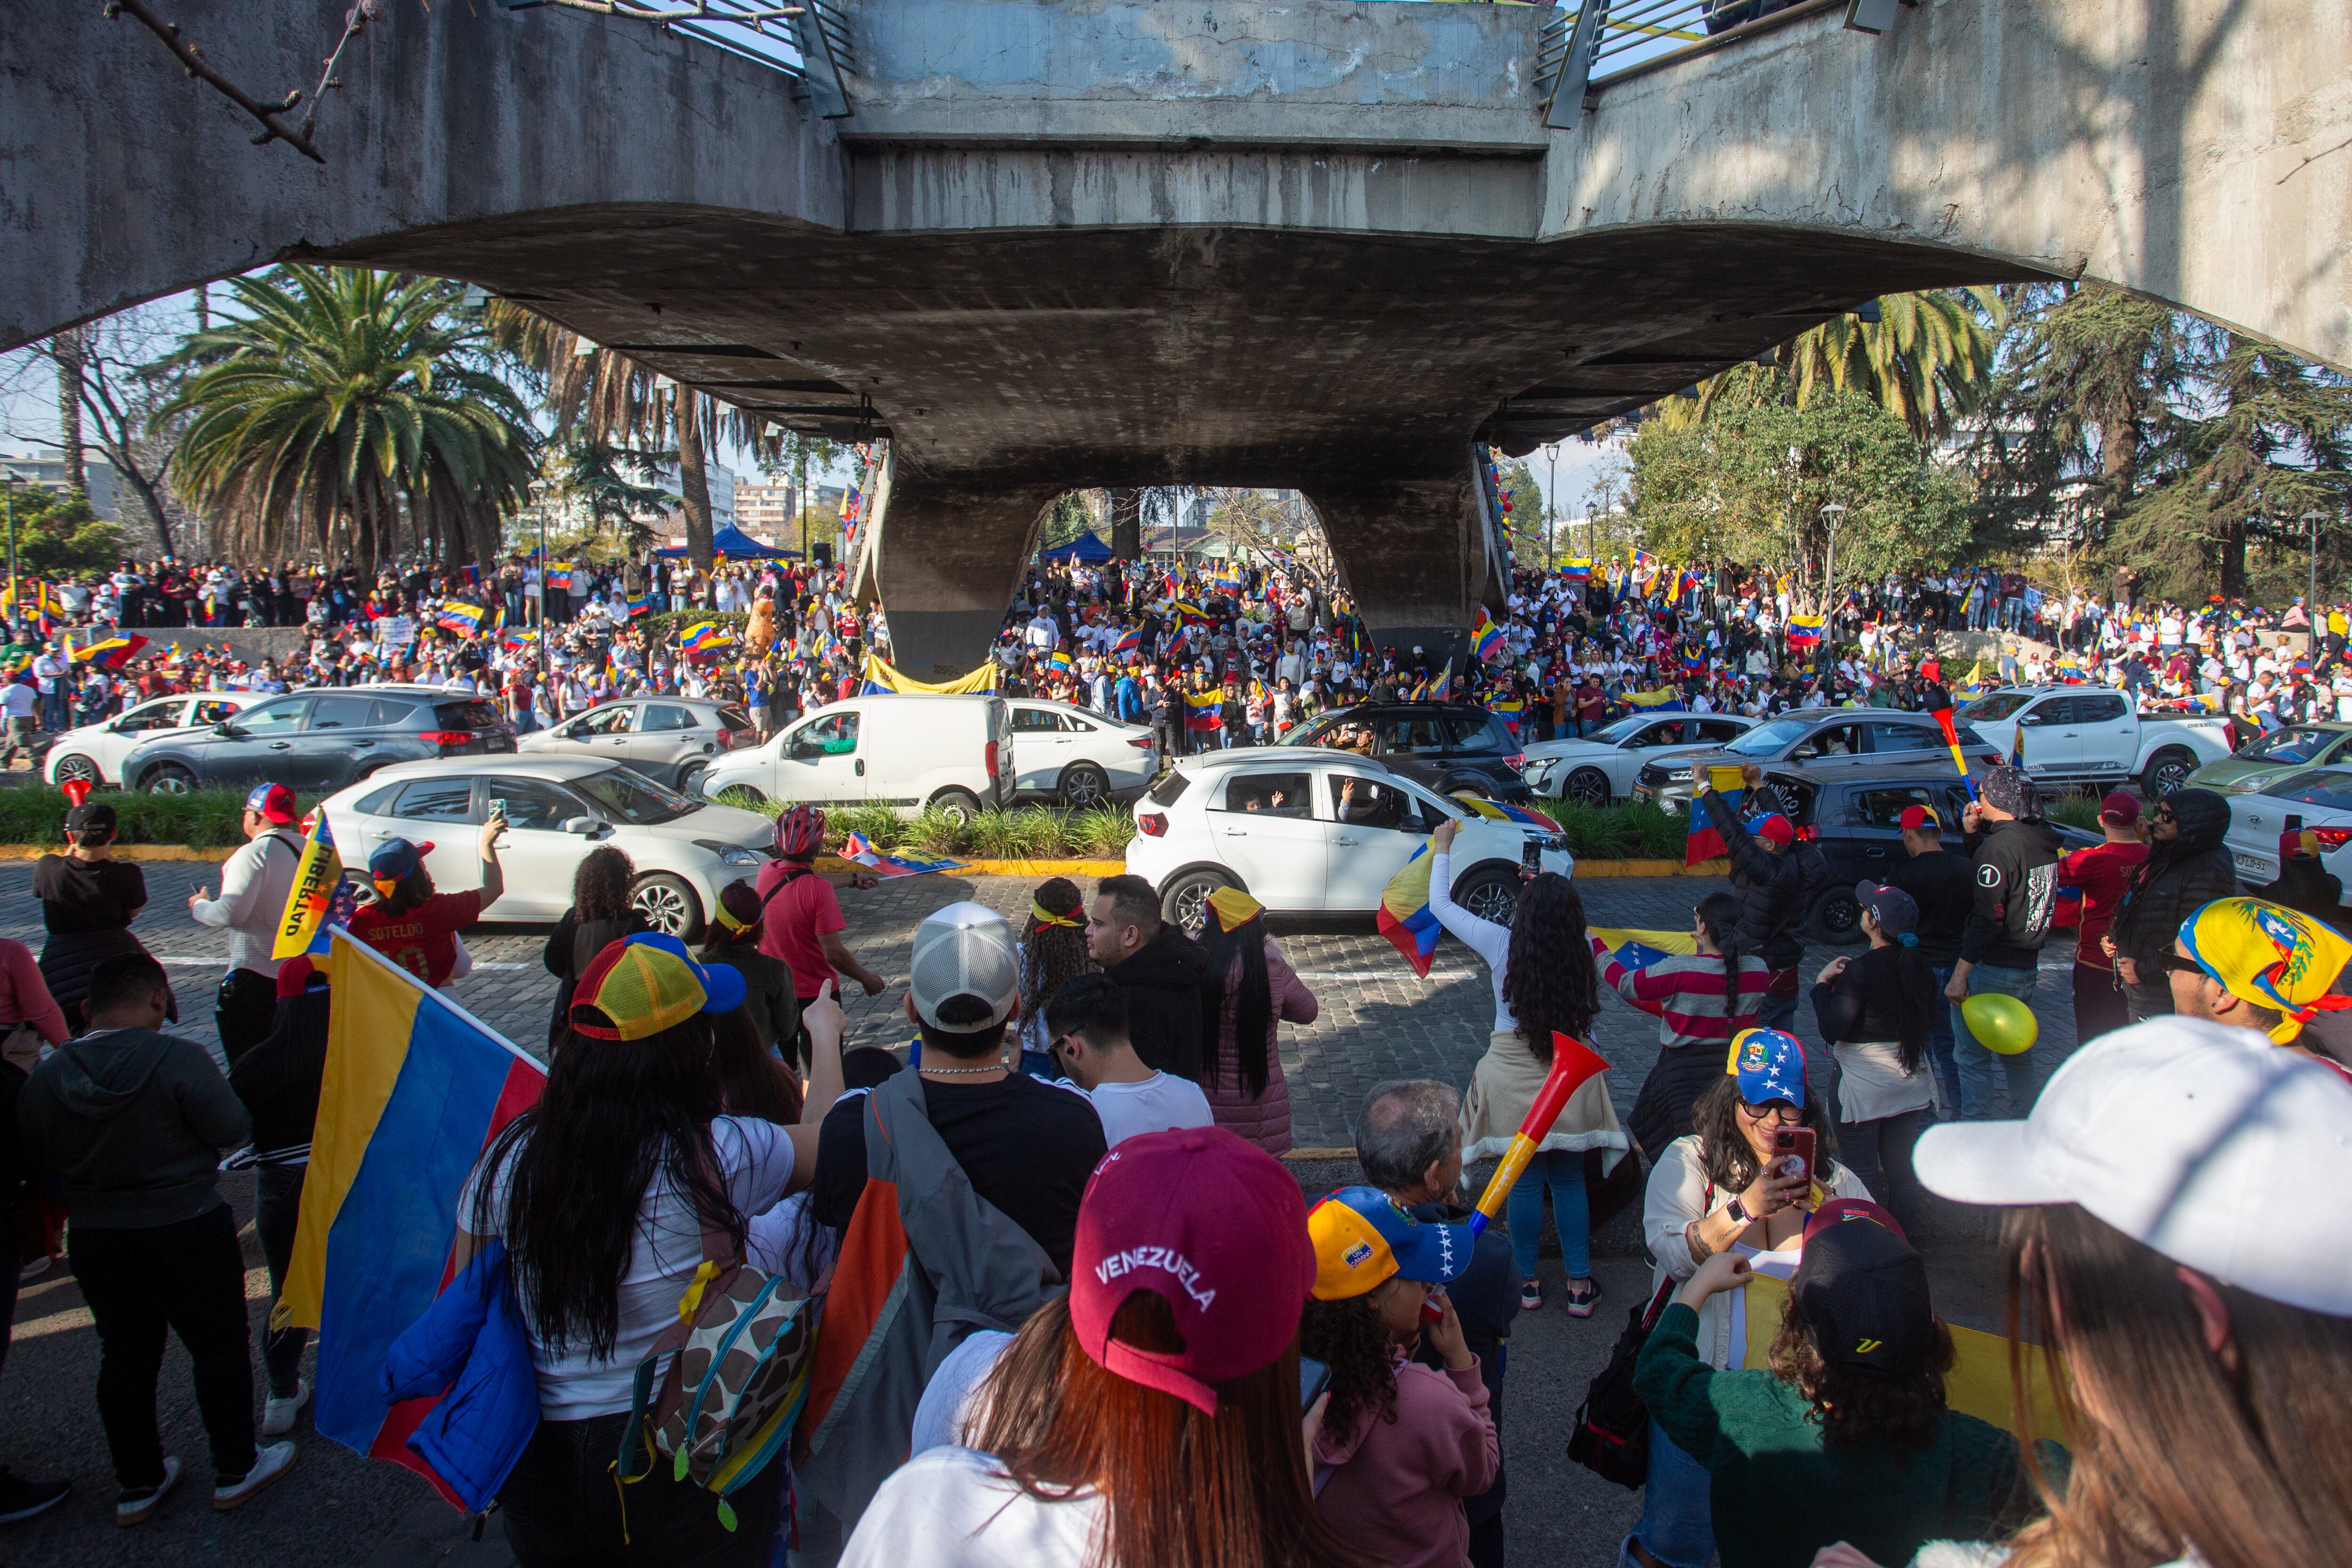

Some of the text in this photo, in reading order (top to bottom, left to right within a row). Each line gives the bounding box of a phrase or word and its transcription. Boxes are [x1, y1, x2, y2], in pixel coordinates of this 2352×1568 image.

[1981, 868, 1992, 884] 1
[368, 922, 423, 941] SOTELDO
[1351, 1250, 1372, 1267] CAMINO
[1095, 1245, 1217, 1313] VENEZUELA
